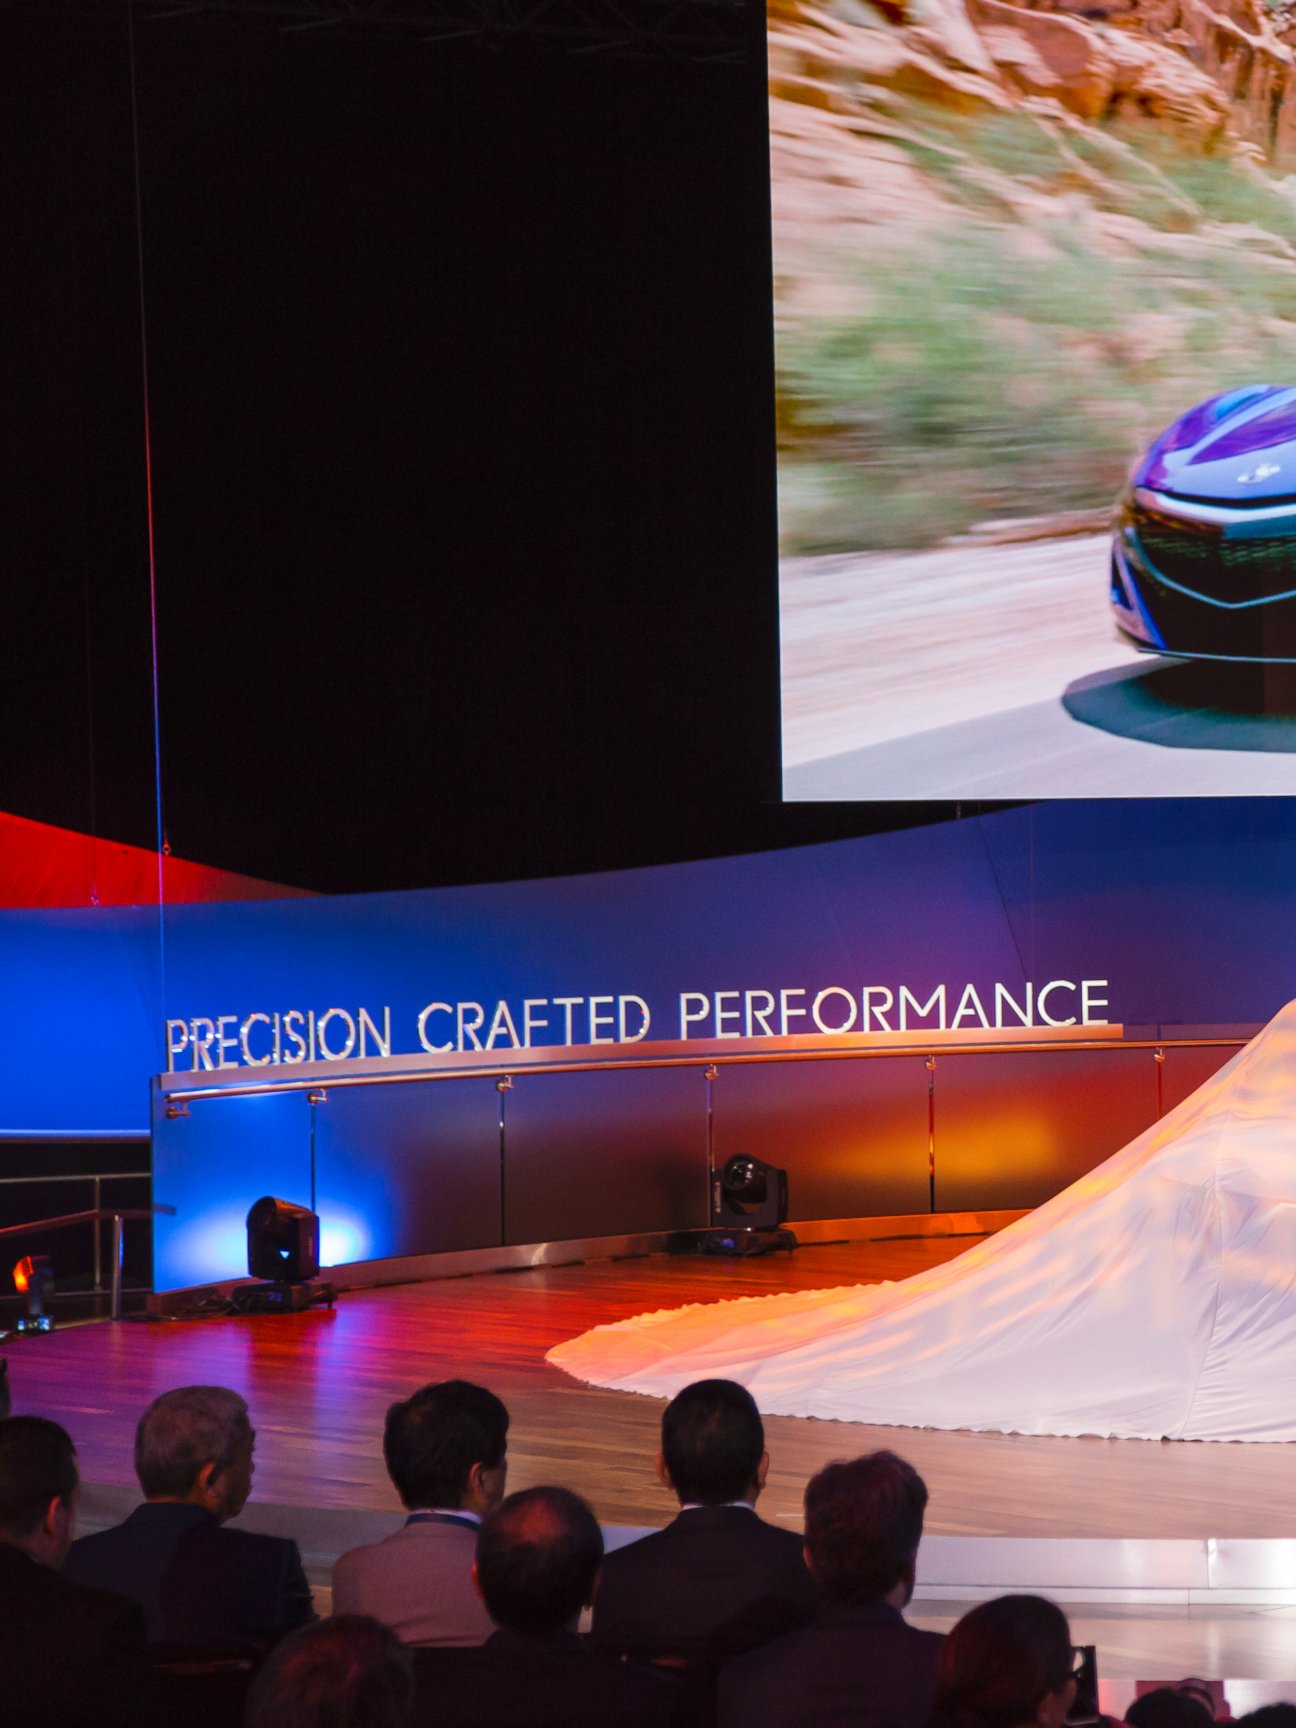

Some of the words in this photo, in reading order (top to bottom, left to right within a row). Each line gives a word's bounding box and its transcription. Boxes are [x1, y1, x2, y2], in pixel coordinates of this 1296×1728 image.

[166, 1006, 391, 1074] PRECISION
[417, 994, 651, 1054] CRAFTED
[678, 979, 1109, 1041] PERFORMANCE
